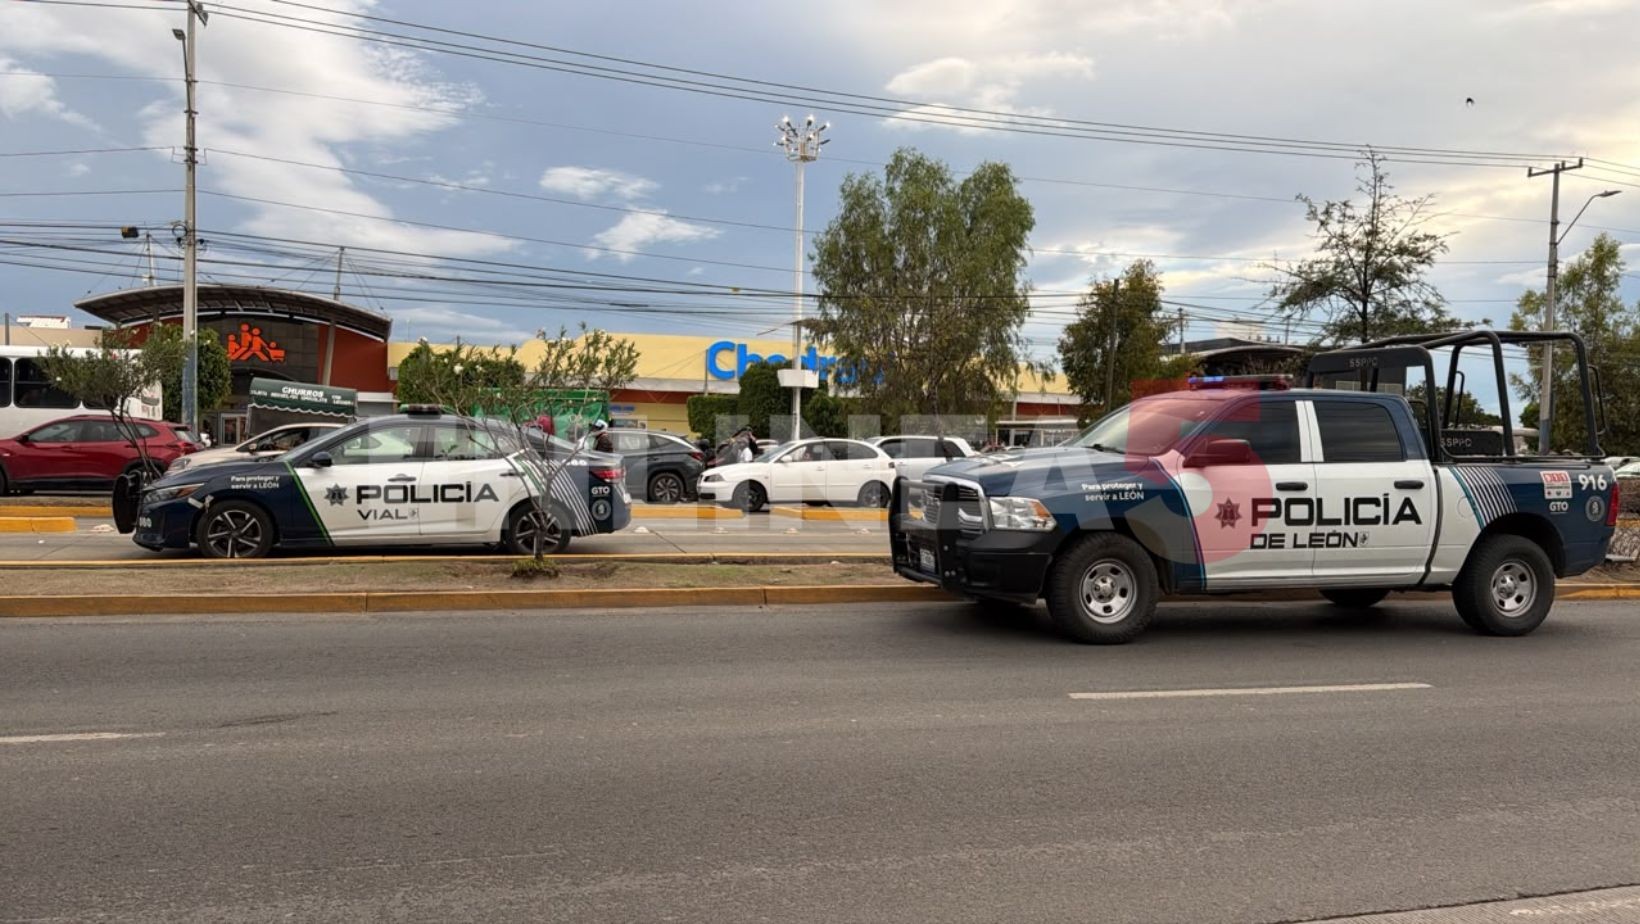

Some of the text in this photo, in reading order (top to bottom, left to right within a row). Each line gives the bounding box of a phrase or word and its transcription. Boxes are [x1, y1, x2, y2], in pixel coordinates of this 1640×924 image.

[282, 386, 324, 398] CHURROS
[1081, 483, 1101, 491] Para
[1102, 482, 1136, 491] proteger
[1578, 474, 1607, 490] 916
[356, 481, 499, 504] POLICÍA
[591, 486, 610, 494] GTO
[1085, 493, 1109, 501] servir
[1119, 490, 1144, 500] LEÓN
[1251, 493, 1422, 526] POLICÍA
[1549, 501, 1569, 512] GTO
[357, 508, 407, 520] VIAL
[1250, 530, 1358, 549] DE LEÓN
